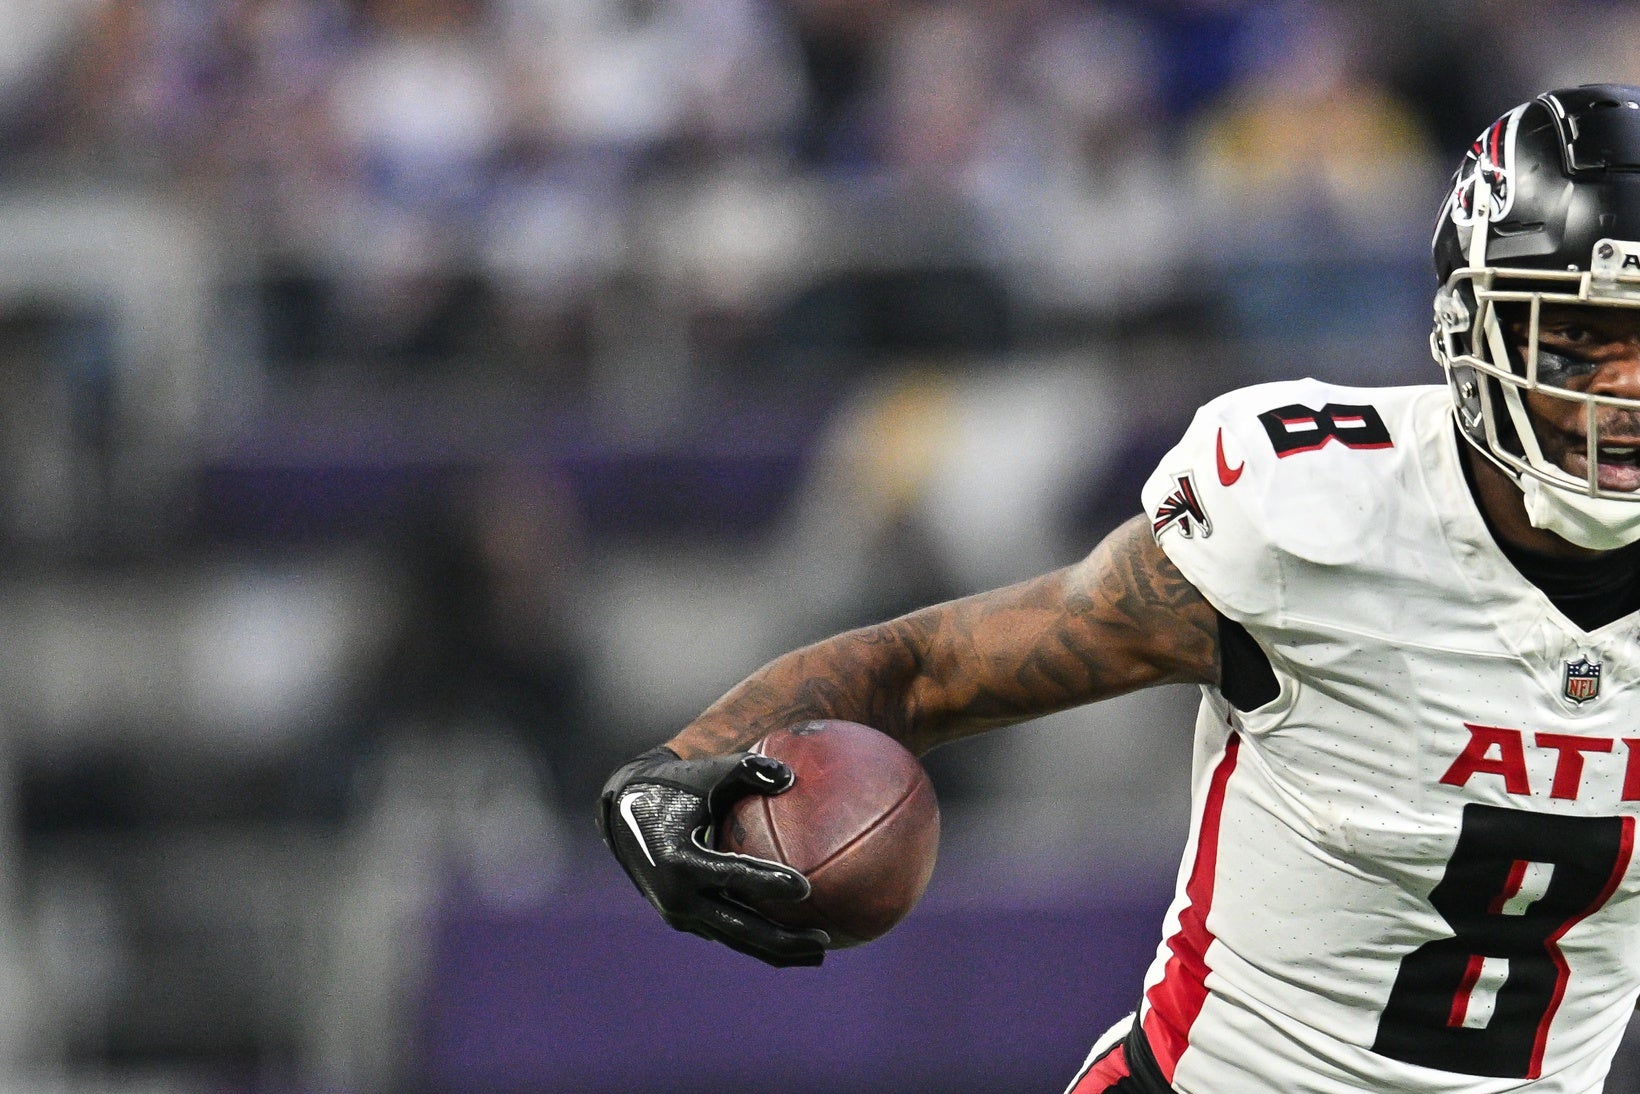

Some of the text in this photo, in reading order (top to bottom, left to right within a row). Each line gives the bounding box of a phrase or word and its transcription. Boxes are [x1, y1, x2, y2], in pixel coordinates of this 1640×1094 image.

[1257, 402, 1395, 460] 8
[1568, 678, 1597, 699] NFL
[1370, 802, 1637, 1081] 8
